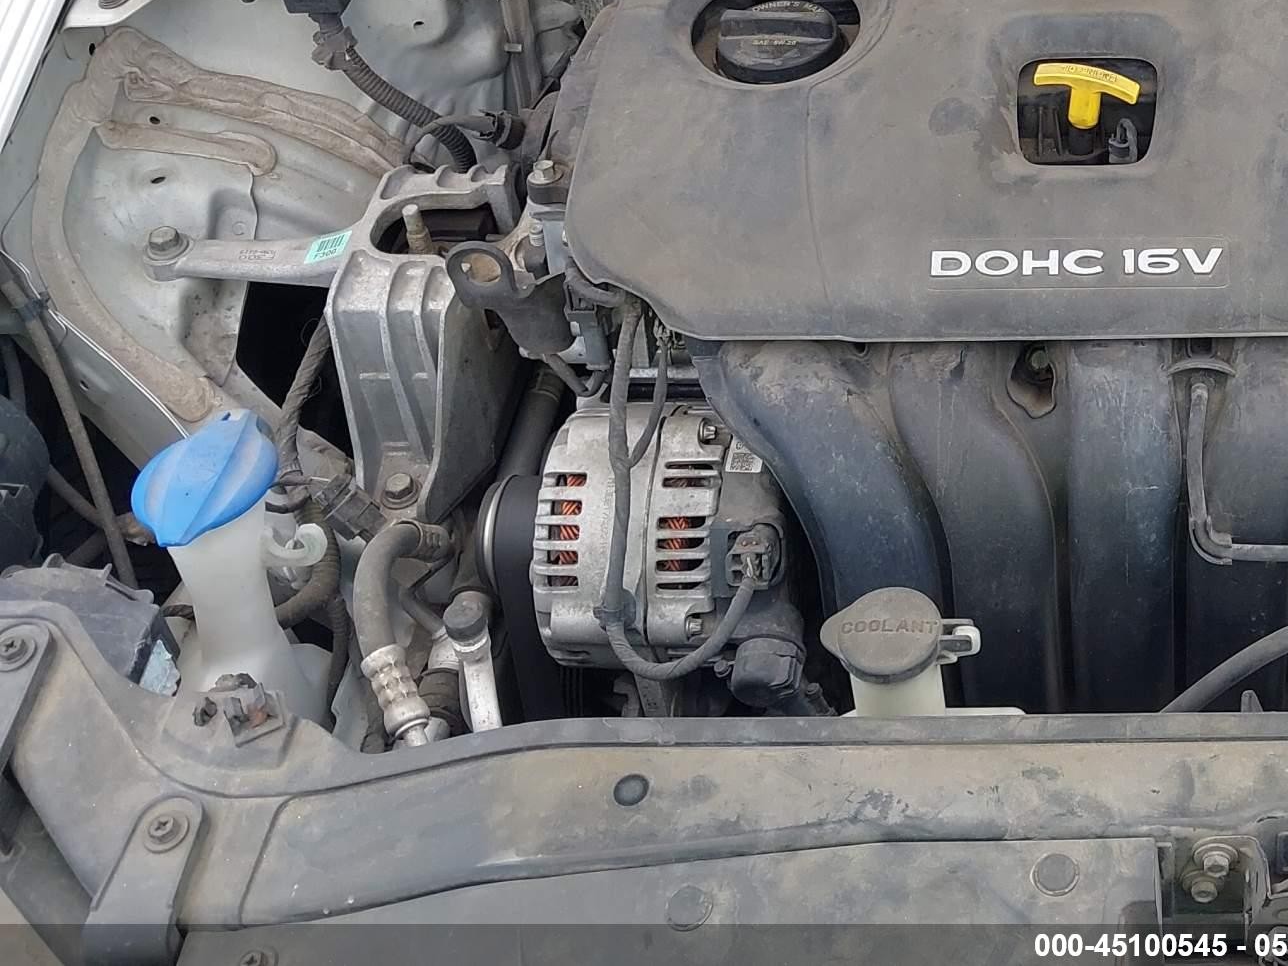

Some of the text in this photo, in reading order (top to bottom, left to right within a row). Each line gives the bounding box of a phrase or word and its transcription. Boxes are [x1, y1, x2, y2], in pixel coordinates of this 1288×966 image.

[930, 247, 1224, 277] DOHC 16V
[841, 618, 938, 635] COOLANT
